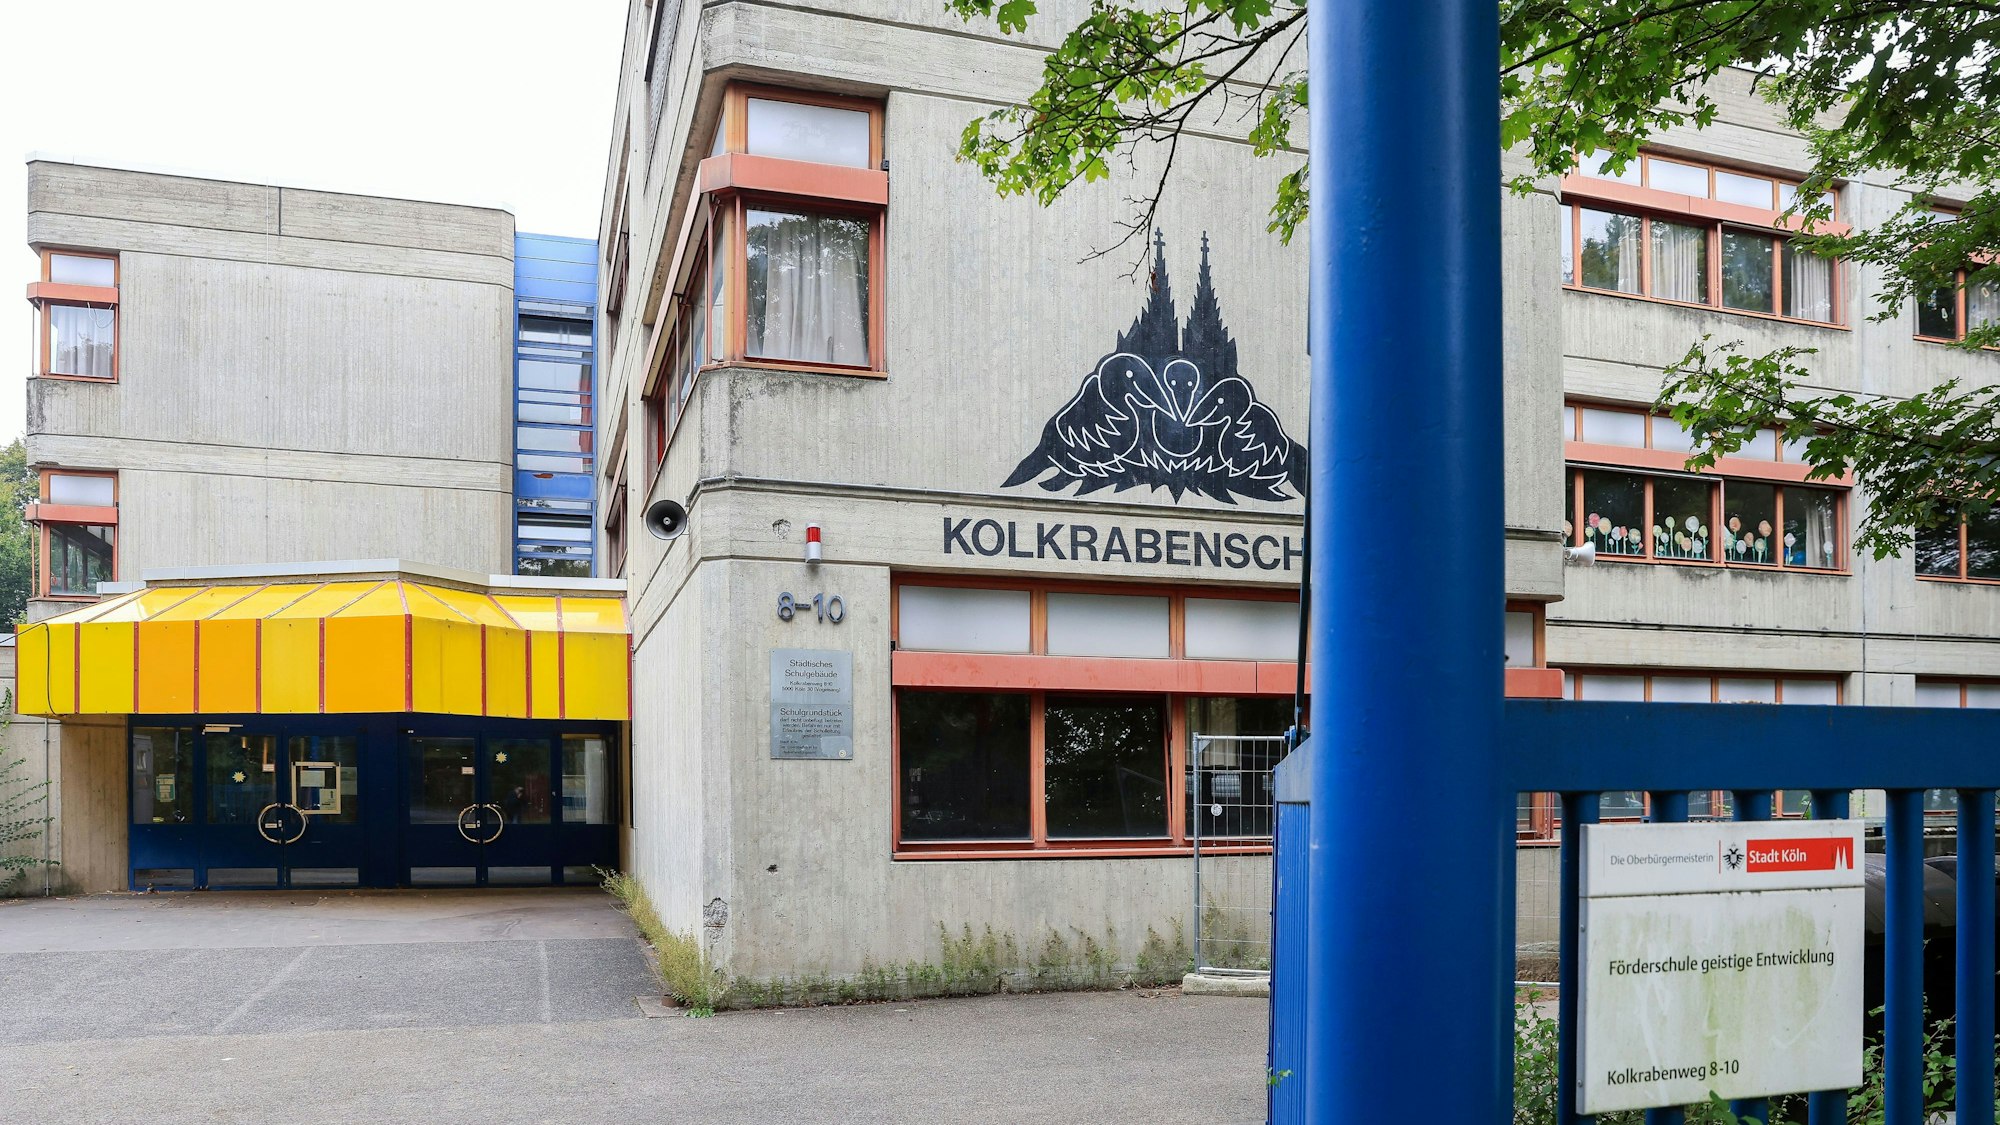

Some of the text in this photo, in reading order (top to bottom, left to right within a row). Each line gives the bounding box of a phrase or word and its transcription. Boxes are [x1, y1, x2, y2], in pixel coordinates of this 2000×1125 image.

[943, 517, 1304, 571] KOLKRABENSCH
[777, 591, 847, 624] 8-10
[789, 659, 833, 668] Städtisches
[785, 669, 838, 679] Schulgebäude
[780, 707, 843, 717] Schulgrundstück
[1610, 853, 1714, 867] Die Oberbürgermeisterin
[1749, 847, 1807, 864] Stadt Köln
[1609, 949, 1834, 976] Förderschule geistige Entwicklung
[1607, 1059, 1740, 1085] Kolkrabenweg 8-10
